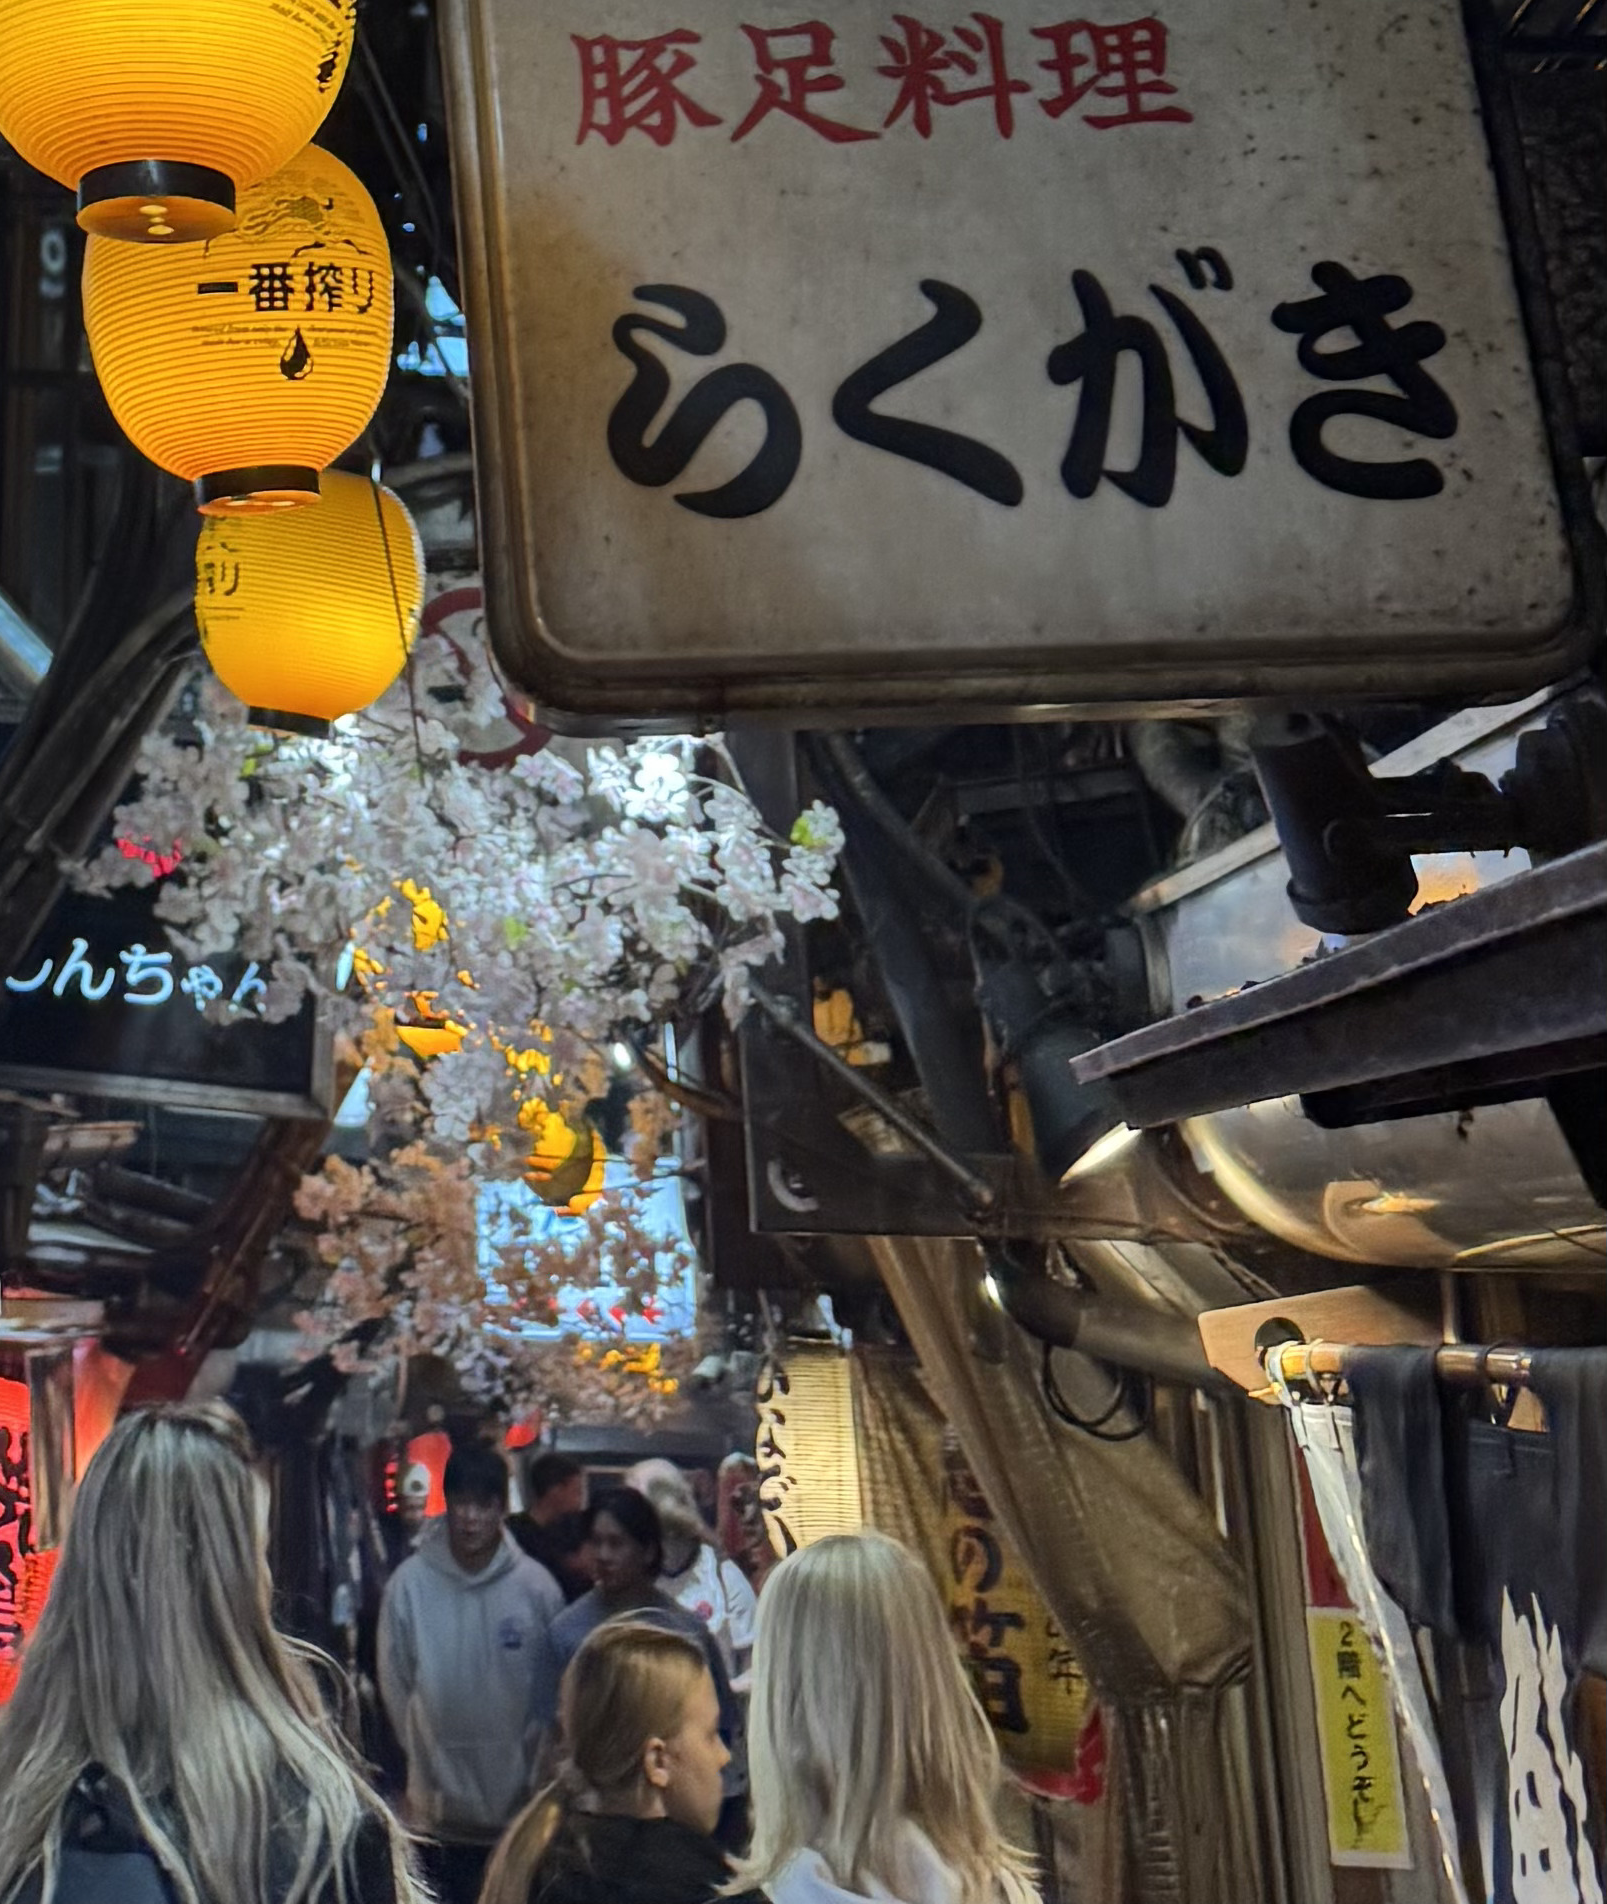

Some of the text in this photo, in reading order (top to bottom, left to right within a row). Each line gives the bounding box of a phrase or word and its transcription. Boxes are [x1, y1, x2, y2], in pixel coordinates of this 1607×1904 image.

[569, 12, 1195, 149] 豚足料理
[197, 261, 374, 314] 一番搾り
[606, 246, 1460, 520] らくがき
